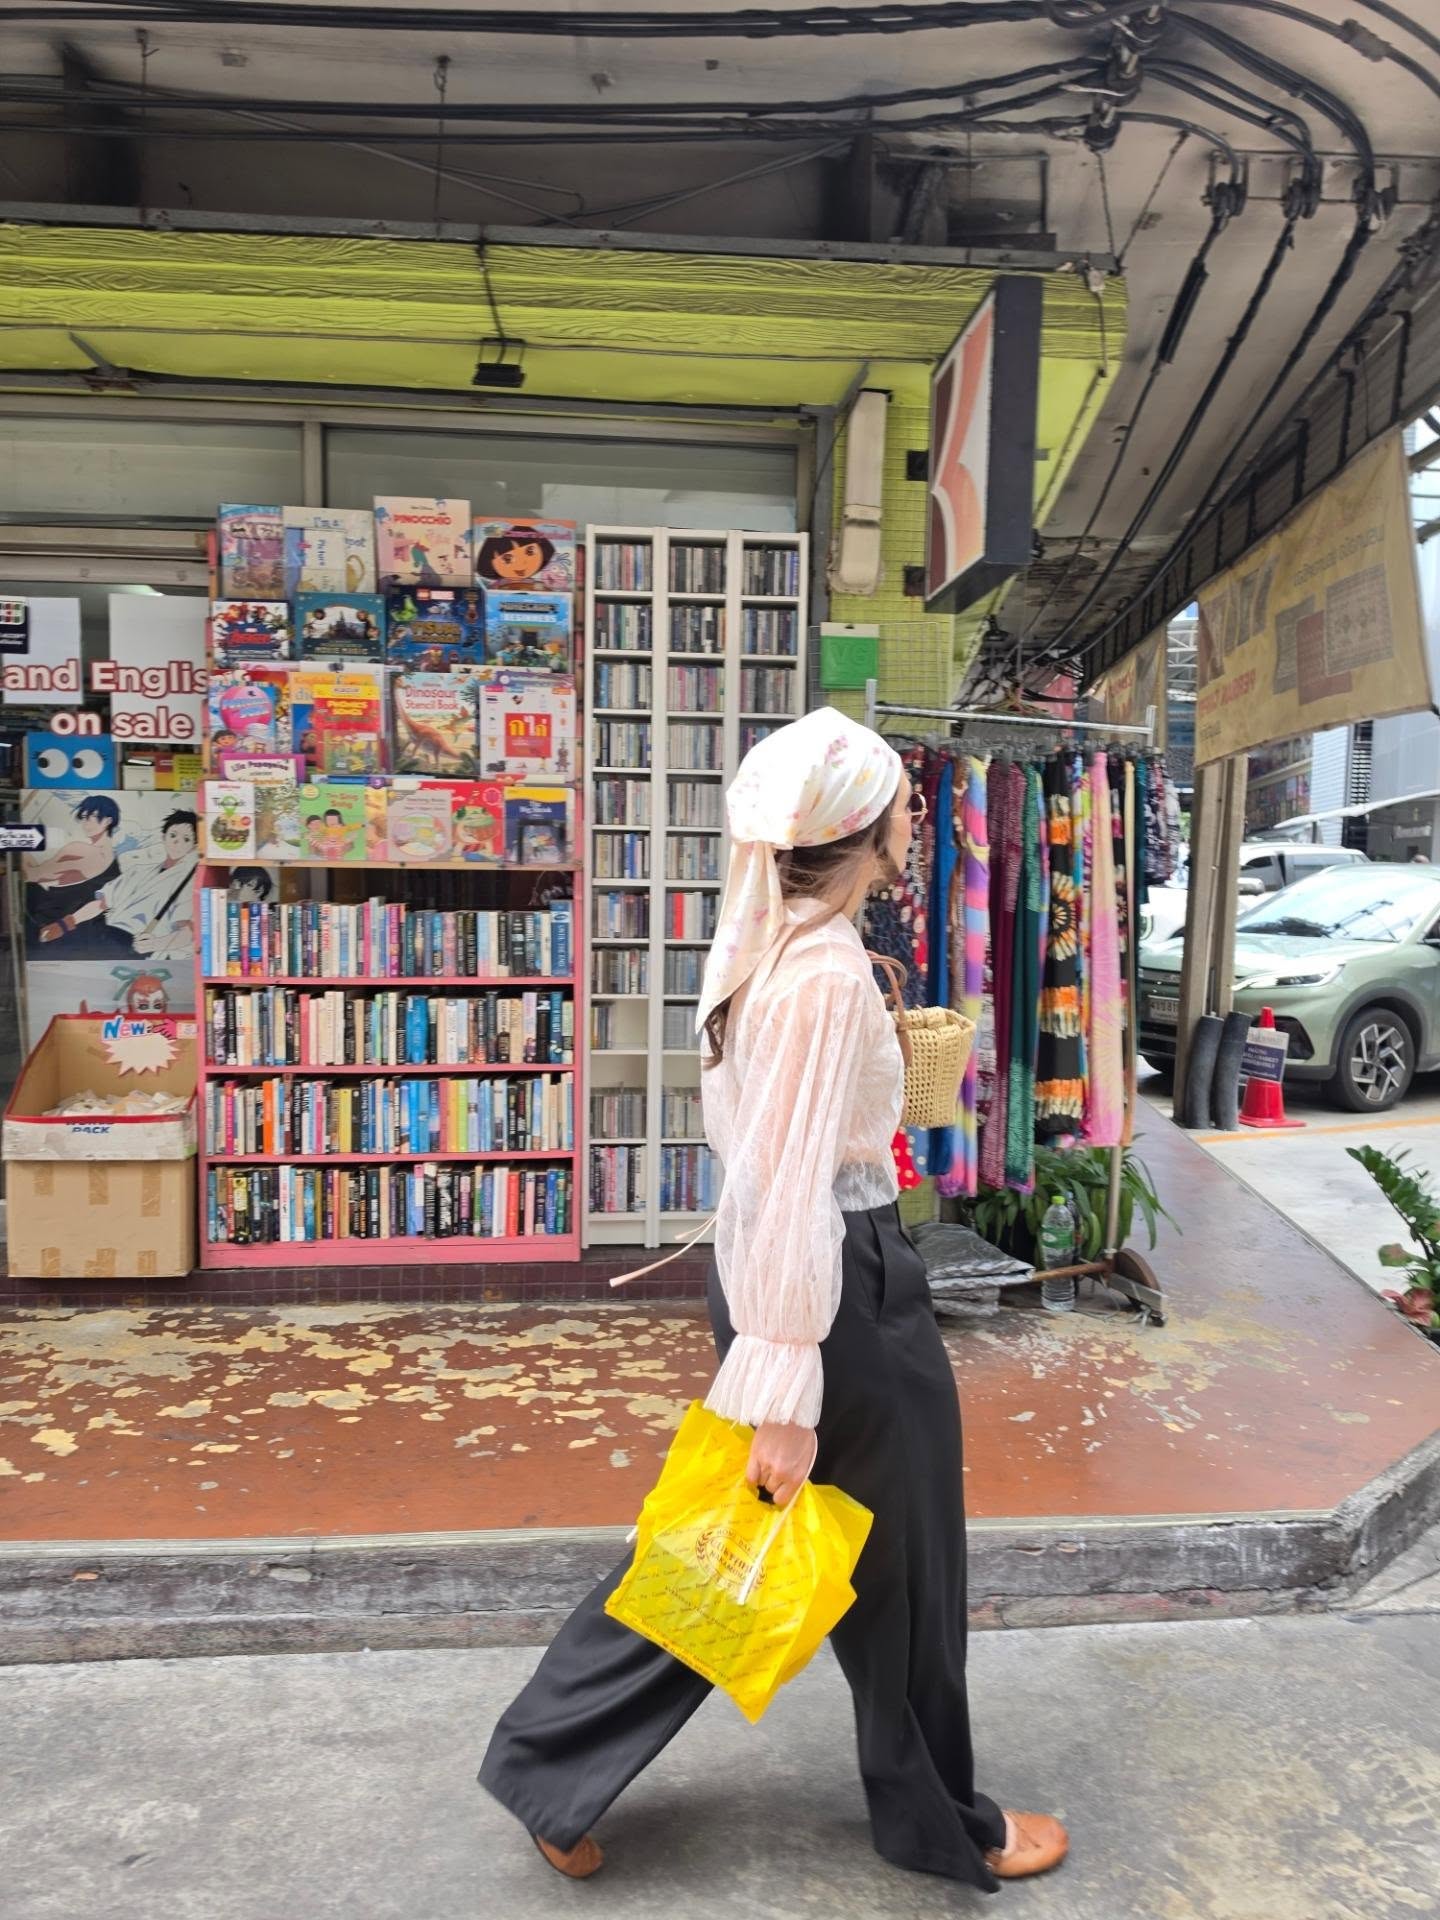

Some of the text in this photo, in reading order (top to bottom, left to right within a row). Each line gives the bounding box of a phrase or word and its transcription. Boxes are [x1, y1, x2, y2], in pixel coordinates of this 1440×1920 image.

[393, 514, 452, 526] PINOCCHIO
[2, 658, 208, 698] and Englis
[405, 687, 457, 699] Dinosaur
[405, 699, 459, 710] Stencil Book
[51, 706, 195, 739] on sale
[228, 917, 240, 954] Thailand
[249, 916, 261, 948] Thailand
[103, 1016, 145, 1039] New
